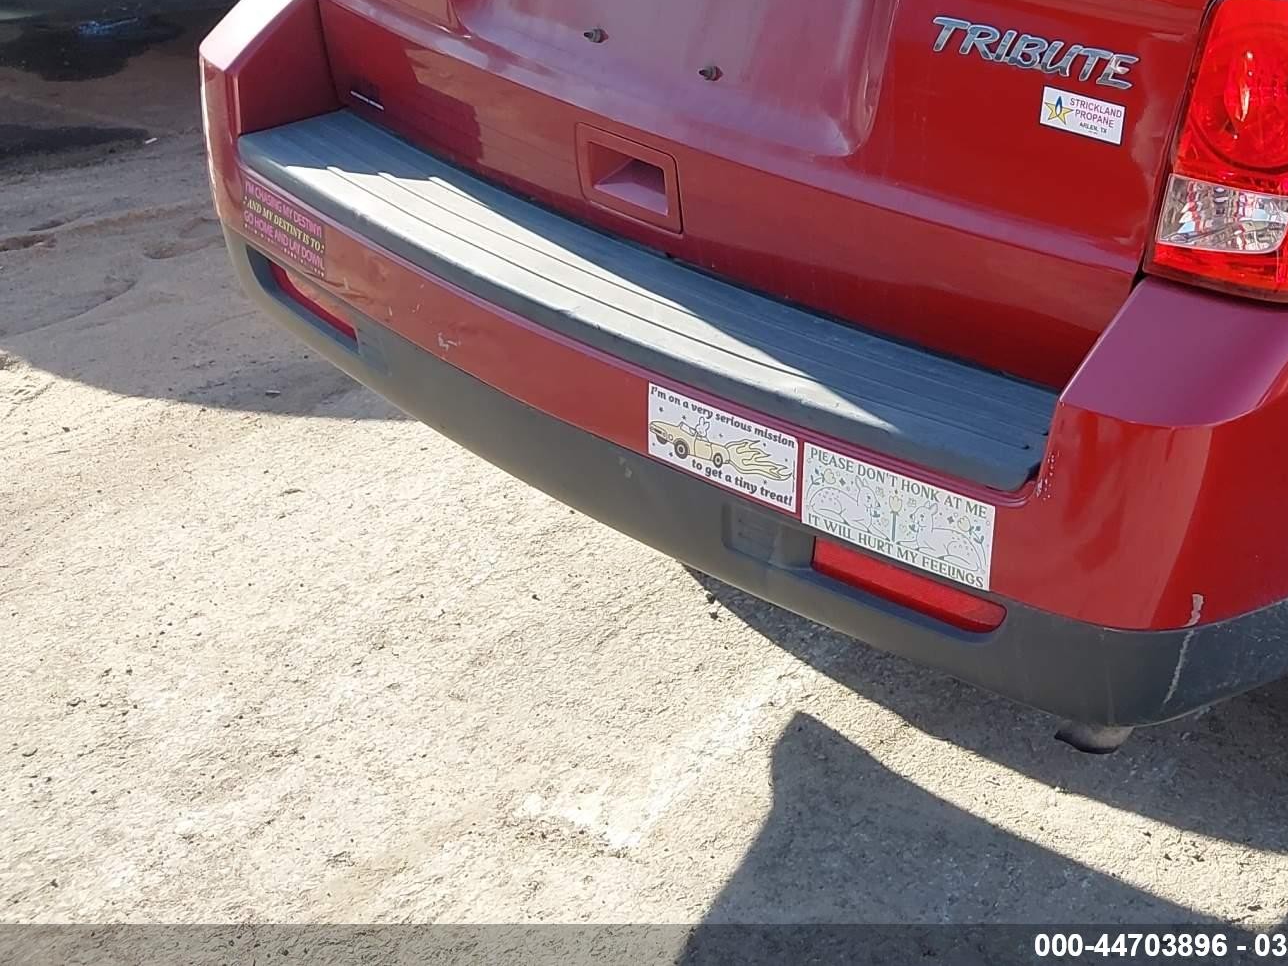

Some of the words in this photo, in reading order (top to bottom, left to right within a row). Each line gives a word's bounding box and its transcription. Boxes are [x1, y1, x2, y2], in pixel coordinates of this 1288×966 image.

[933, 16, 1139, 90] TRIBUTE
[1070, 97, 1122, 118] STRICKLAND
[1075, 109, 1114, 128] PROPANE
[247, 199, 262, 213] AND
[262, 208, 273, 221] MY
[274, 215, 302, 240] DESTINY
[303, 233, 310, 244] IS
[311, 238, 320, 251] TO
[255, 214, 273, 237] HOME
[651, 385, 667, 402] I'm
[668, 396, 681, 406] on
[682, 400, 690, 410] a
[691, 403, 714, 422] very
[715, 411, 752, 434] serious
[754, 423, 795, 448] mission
[691, 459, 703, 470] to
[705, 466, 723, 481] get
[724, 473, 732, 483] a
[734, 474, 758, 495] tiny
[760, 484, 793, 507] treat!
[810, 447, 854, 474] PLEASE
[857, 464, 897, 491] DON'T
[901, 479, 939, 502] HONK
[943, 495, 963, 509] AT
[965, 502, 988, 519] ME
[807, 513, 822, 528] IT
[824, 519, 855, 539] WILL
[858, 532, 893, 553] HURT
[897, 545, 918, 564] MY
[921, 555, 984, 589] FEELINGS
